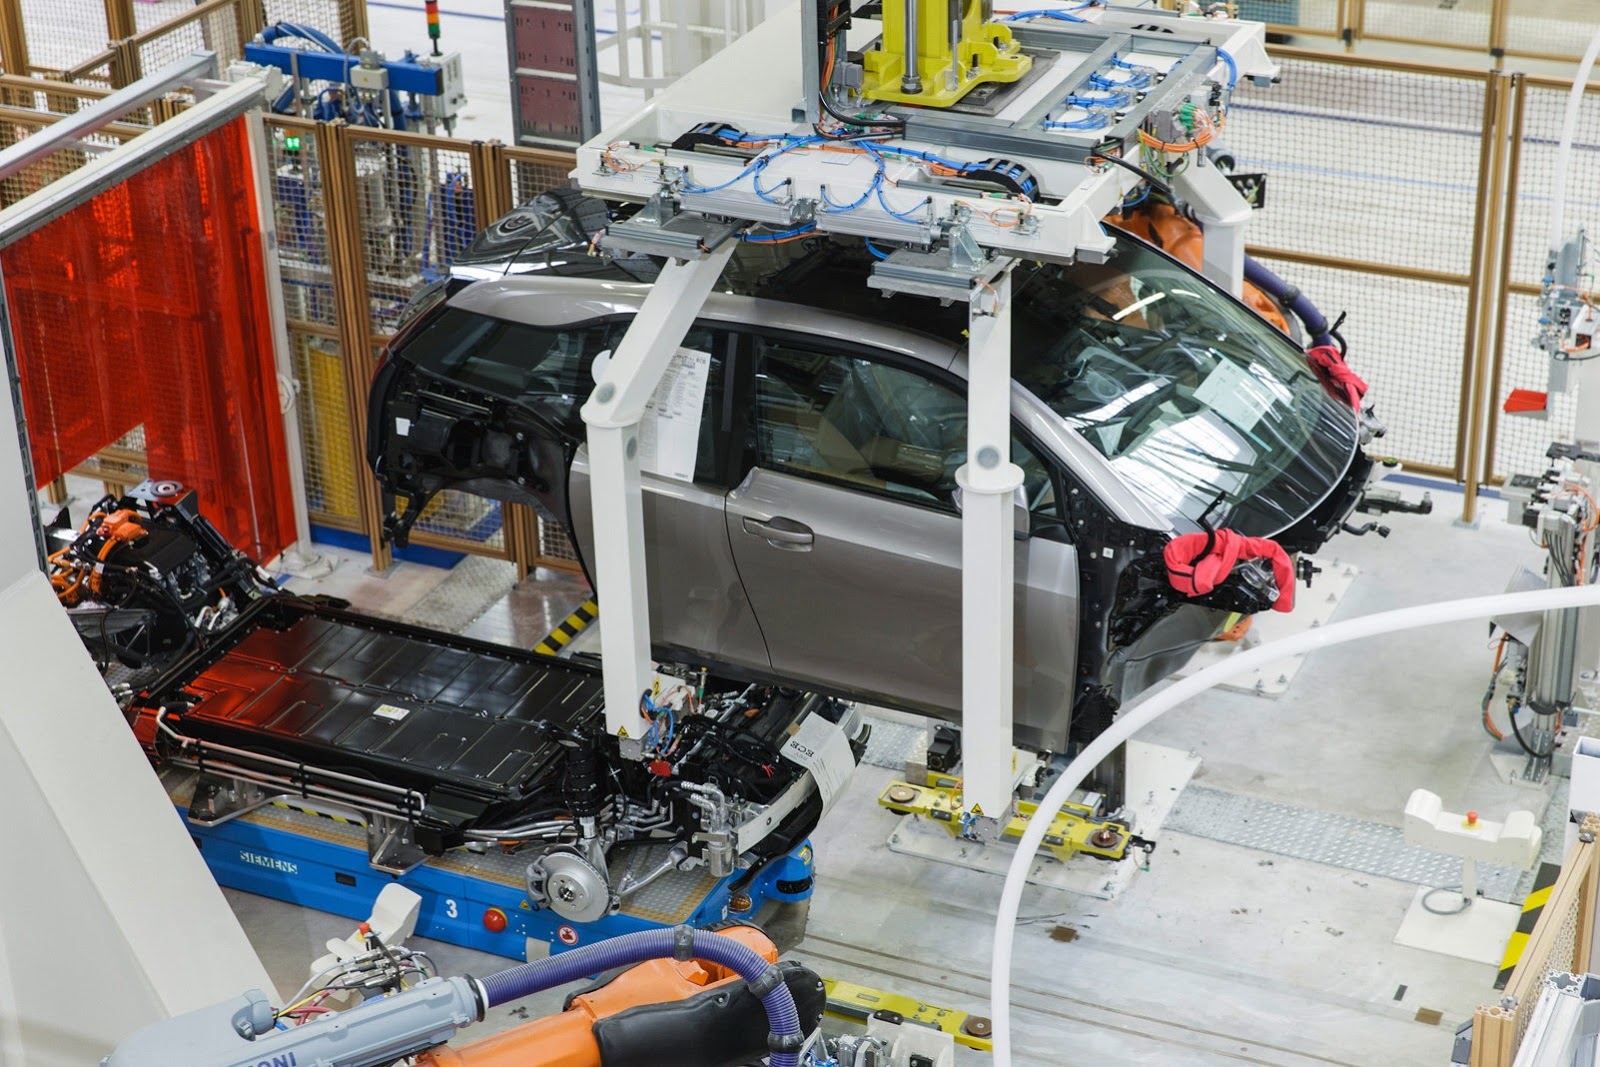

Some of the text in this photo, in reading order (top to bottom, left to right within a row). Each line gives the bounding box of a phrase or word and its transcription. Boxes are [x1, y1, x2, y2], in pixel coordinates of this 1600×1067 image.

[790, 740, 814, 758] ECE
[240, 850, 298, 875] SIEMENS
[445, 899, 458, 919] 3
